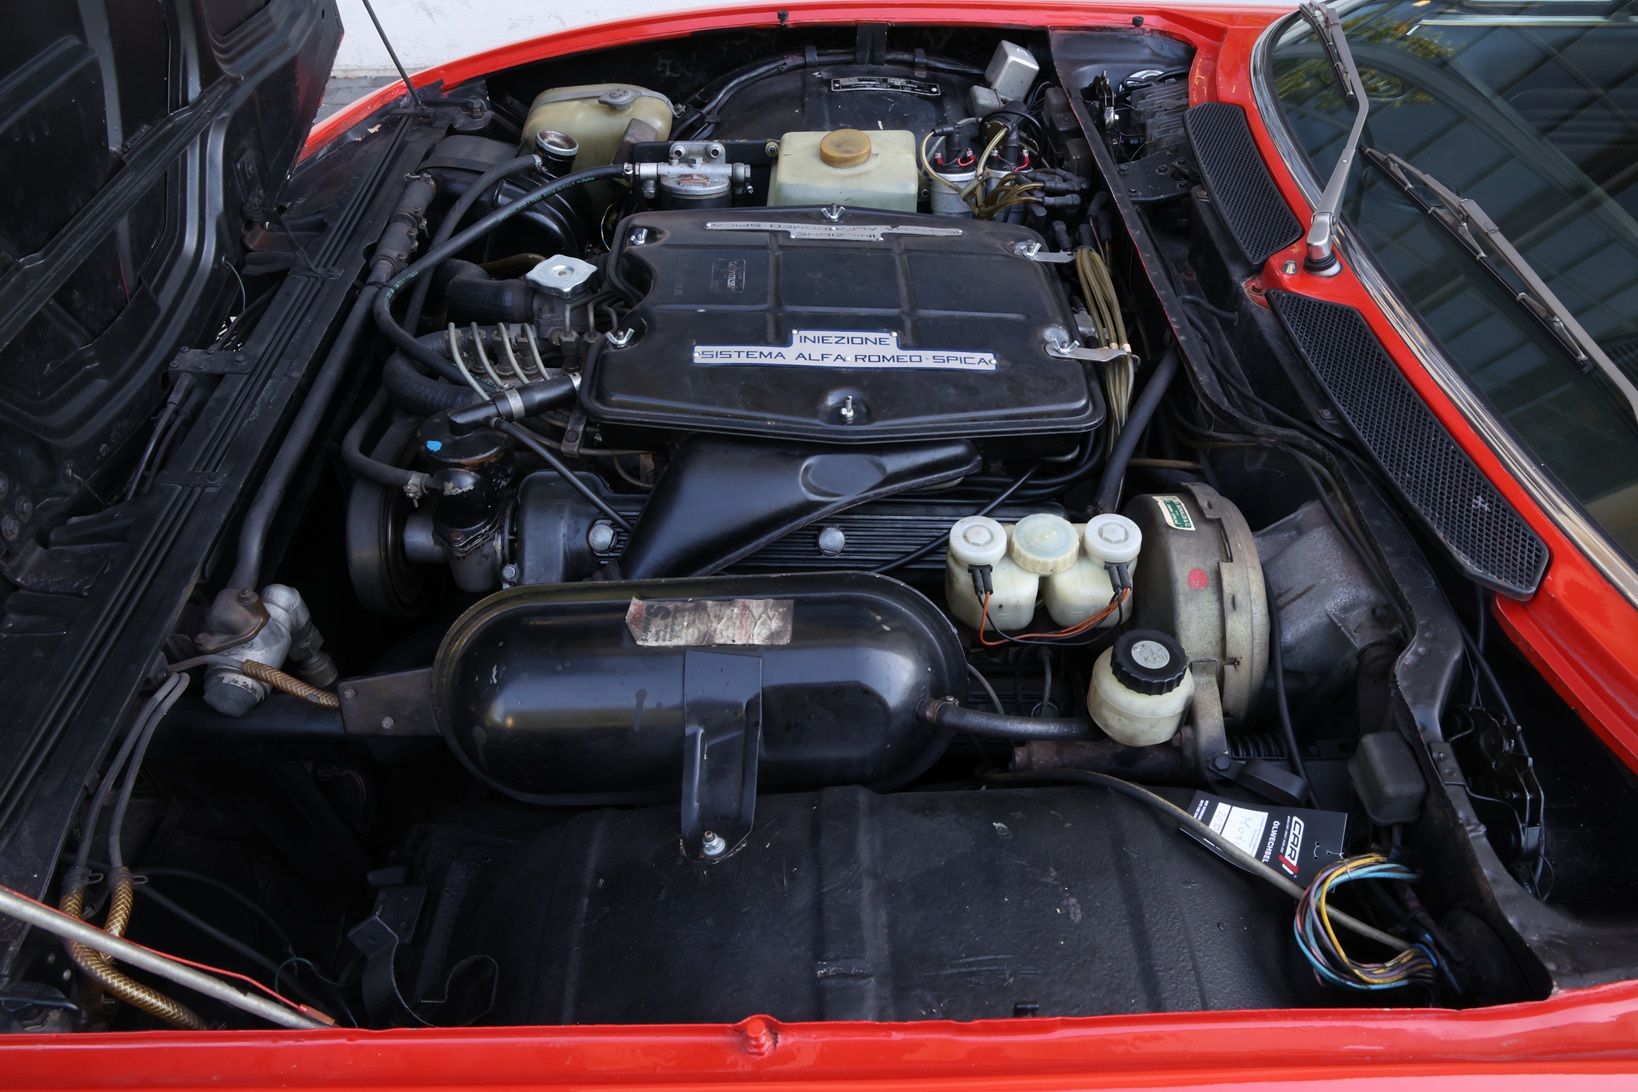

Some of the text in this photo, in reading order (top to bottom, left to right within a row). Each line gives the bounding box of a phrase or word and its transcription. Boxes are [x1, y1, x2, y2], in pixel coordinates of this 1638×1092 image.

[799, 335, 891, 346] INIEZIONE
[701, 350, 990, 366] SISTEMA ALFA ROMEO SPICA
